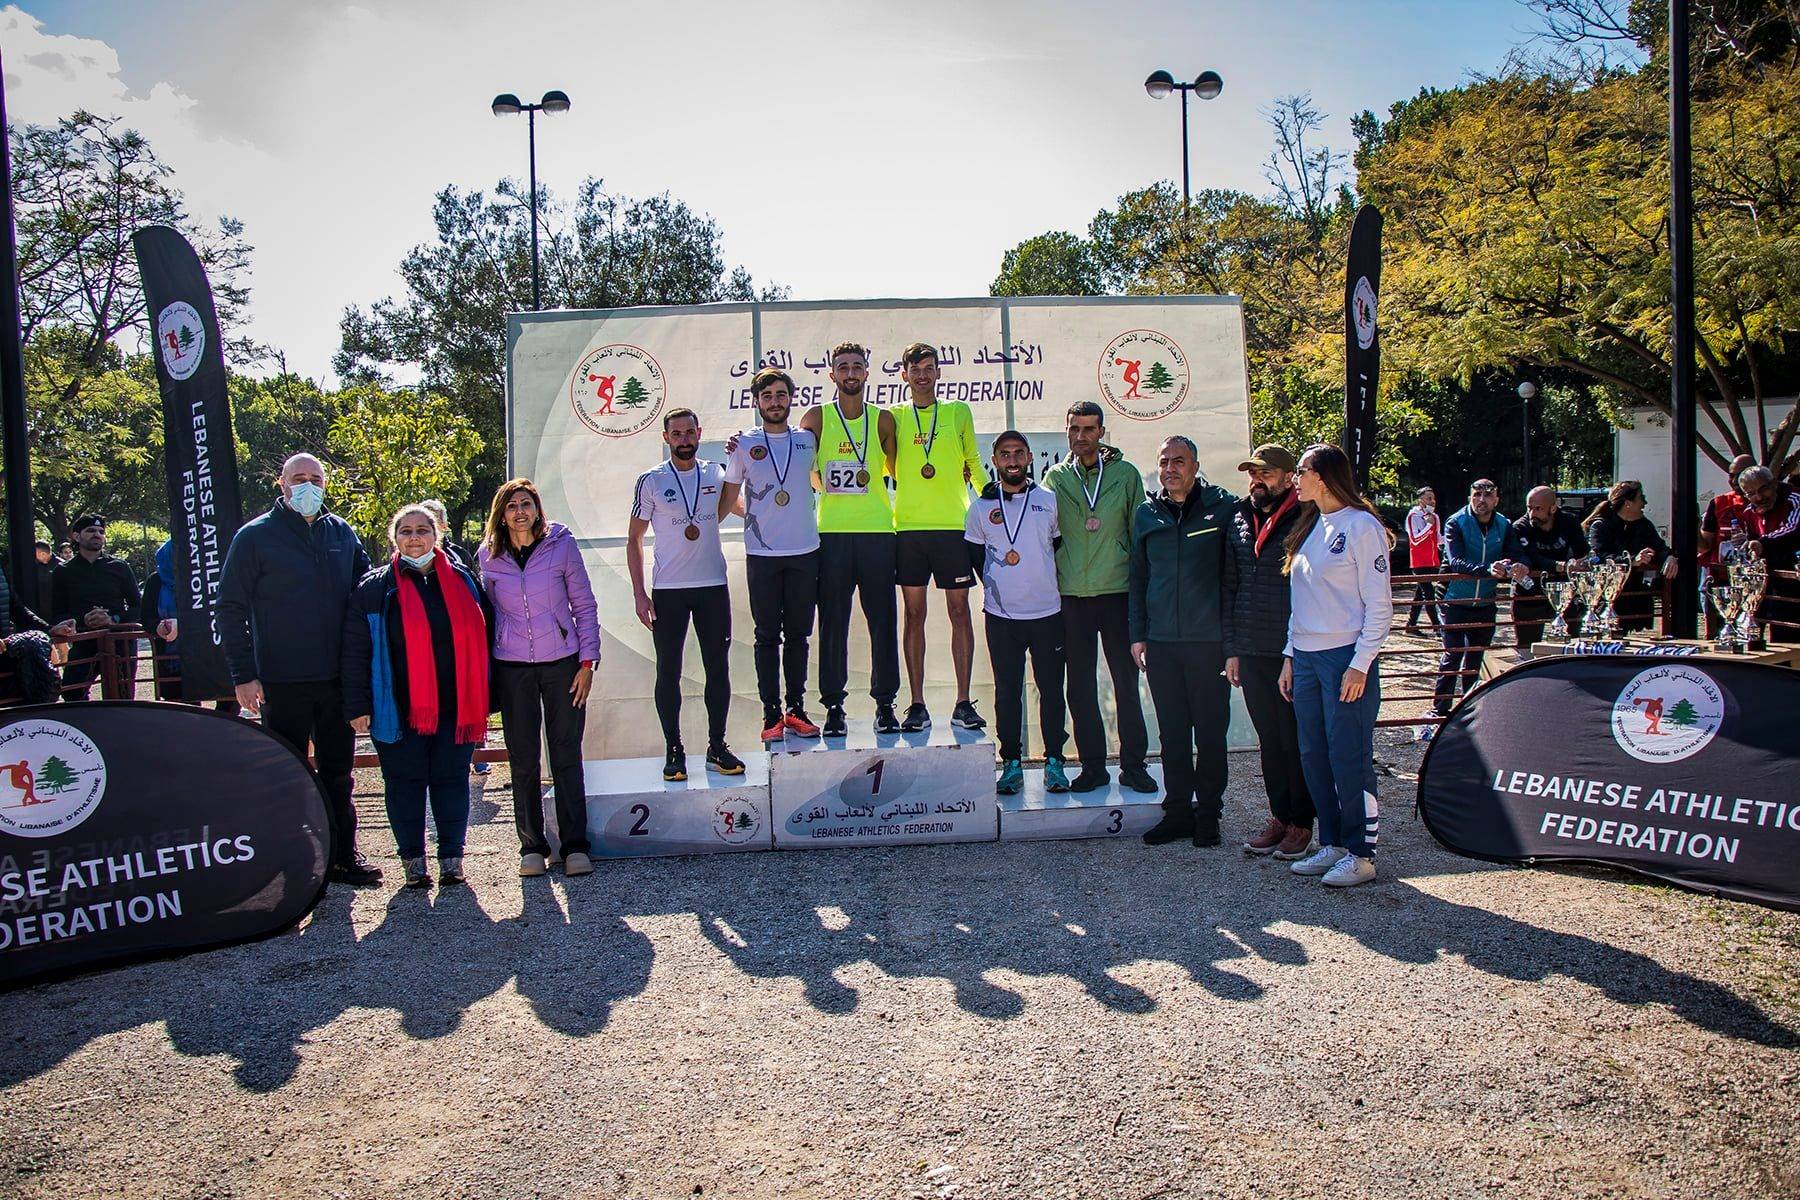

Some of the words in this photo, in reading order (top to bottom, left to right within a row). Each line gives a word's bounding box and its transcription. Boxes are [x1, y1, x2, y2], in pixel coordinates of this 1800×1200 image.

[729, 386, 823, 410] LEESE
[936, 380, 1043, 402] FEDERATION
[191, 400, 215, 518] LEBANESE
[830, 470, 868, 488] 52
[183, 470, 203, 609] FEDERATION
[1616, 704, 1638, 714] 1965
[865, 759, 885, 795] 1
[1493, 769, 1642, 811] LEBANESE
[20, 819, 63, 829] LIBANAISE
[628, 803, 650, 836] 2
[791, 806, 829, 824] القوى
[881, 801, 928, 822] اللبناني
[1106, 809, 1123, 834] 3
[812, 826, 854, 839] LEBANESE
[857, 824, 900, 836] ATHLETICS
[904, 822, 954, 834] FEDERATION
[1540, 812, 1740, 863] FEDERATION
[60, 835, 255, 892] ATHLETICS
